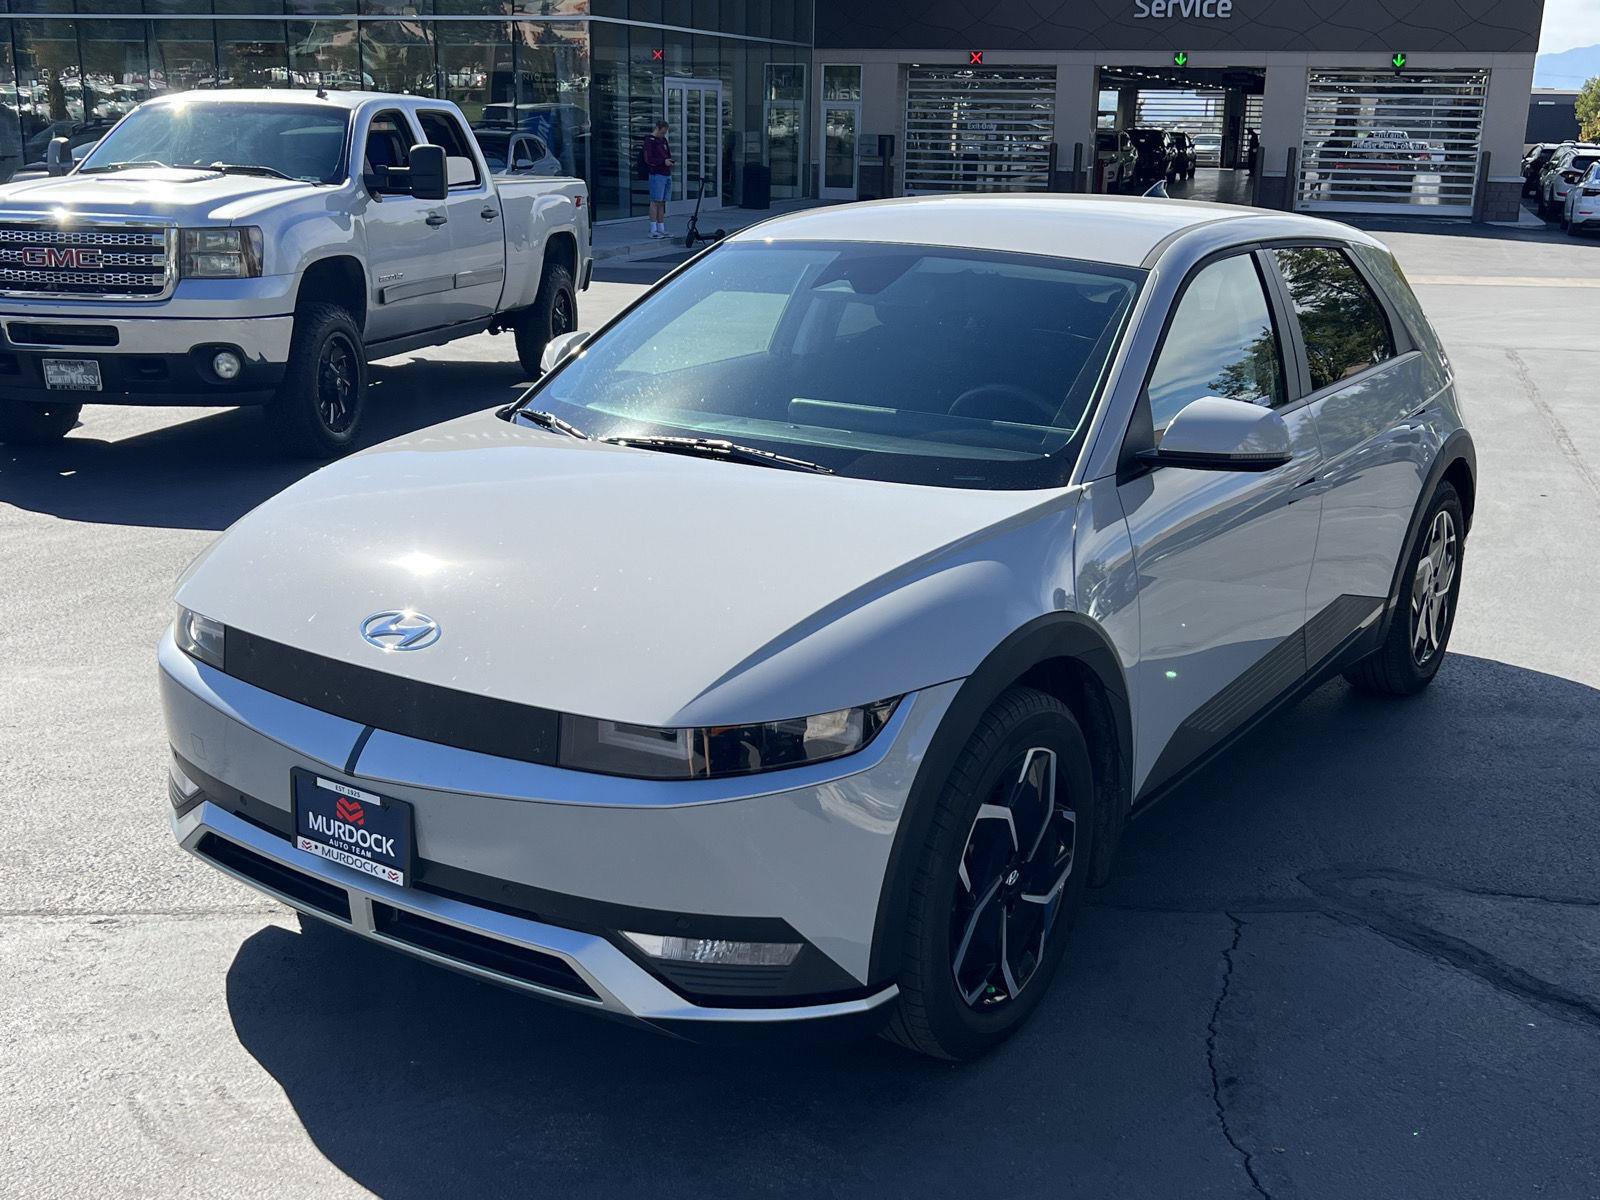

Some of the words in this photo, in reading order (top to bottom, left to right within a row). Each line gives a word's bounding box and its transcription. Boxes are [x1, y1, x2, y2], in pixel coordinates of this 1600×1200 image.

[1133, 0, 1232, 18] Service
[22, 246, 103, 269] GMC
[335, 784, 347, 792] EST
[347, 788, 361, 798] 1925
[308, 811, 395, 858] MURDOCK
[329, 838, 349, 851] AUTO
[351, 845, 372, 858] TEAM
[321, 846, 379, 875] MURDOCK
